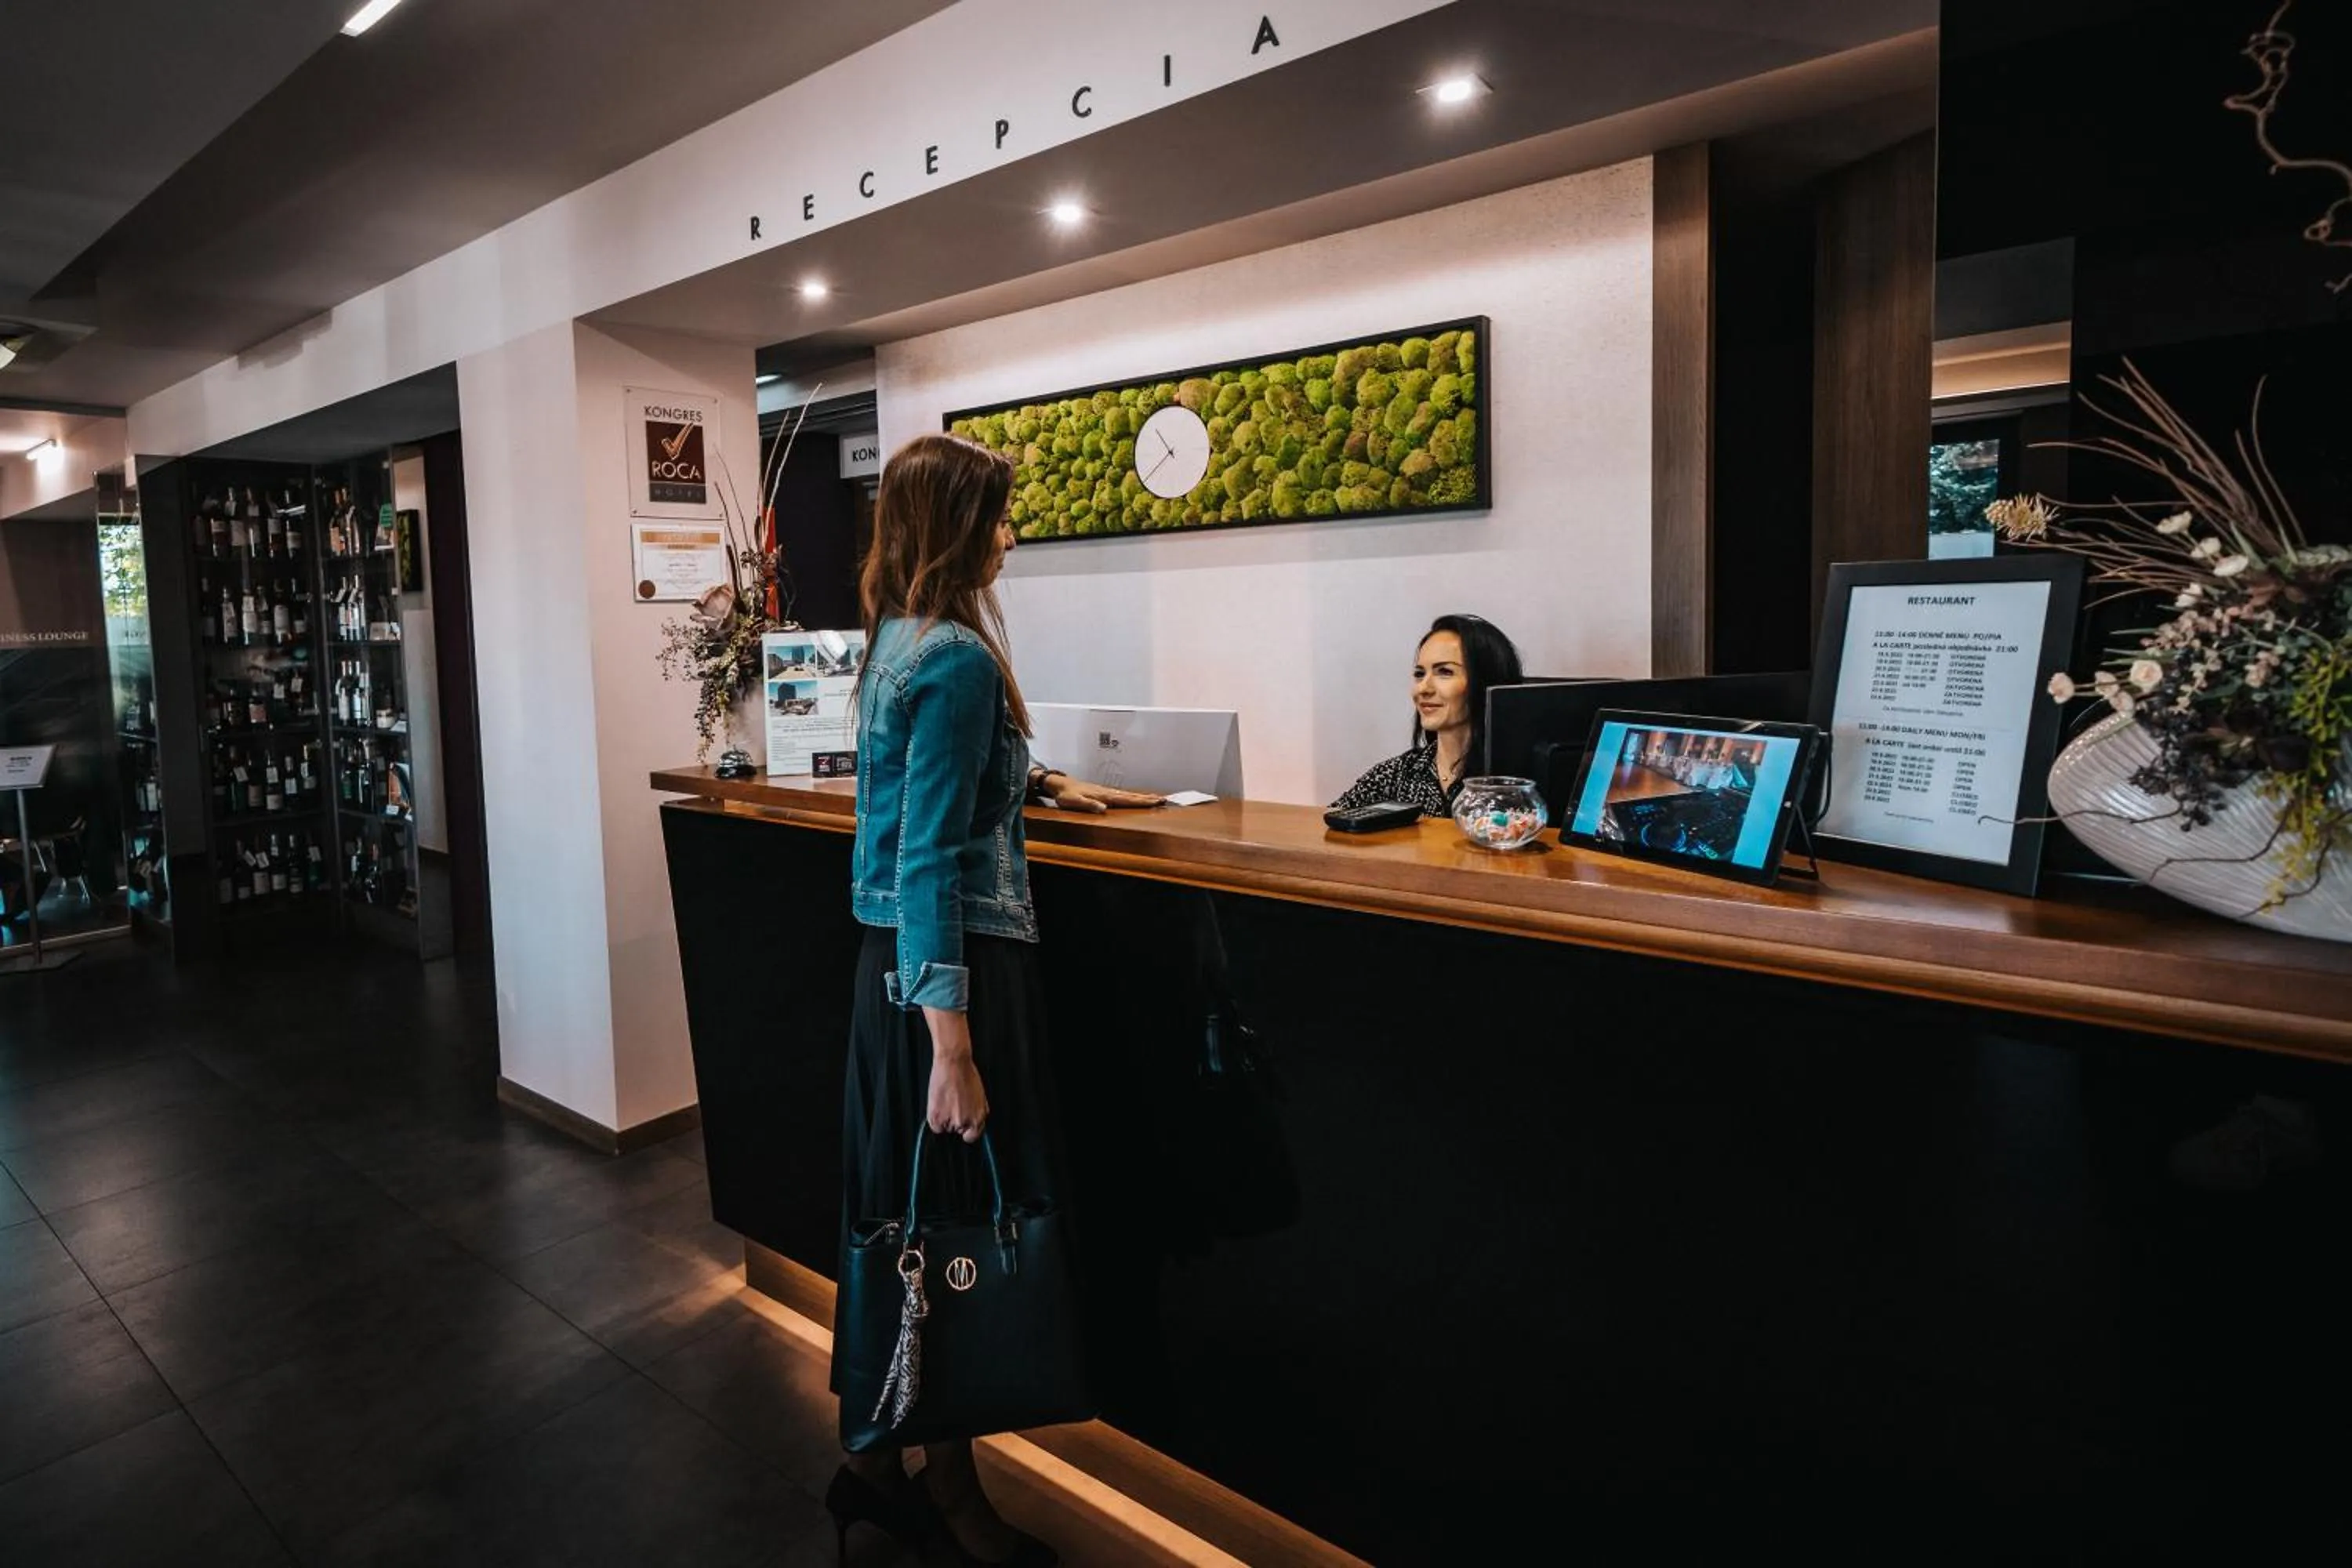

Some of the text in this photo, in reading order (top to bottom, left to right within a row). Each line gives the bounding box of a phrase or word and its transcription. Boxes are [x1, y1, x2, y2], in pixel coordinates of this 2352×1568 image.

[750, 16, 1279, 241] RECEPCIA
[644, 406, 703, 422] KONGRES
[852, 446, 880, 462] KON
[652, 460, 702, 480] ROCA
[1907, 597, 1976, 605] RESTAURANT
[38, 630, 89, 641] LOUNGE
[1901, 726, 1924, 735] DAILY
[1925, 728, 1947, 737] MENU
[1882, 739, 1904, 748] CARTE
